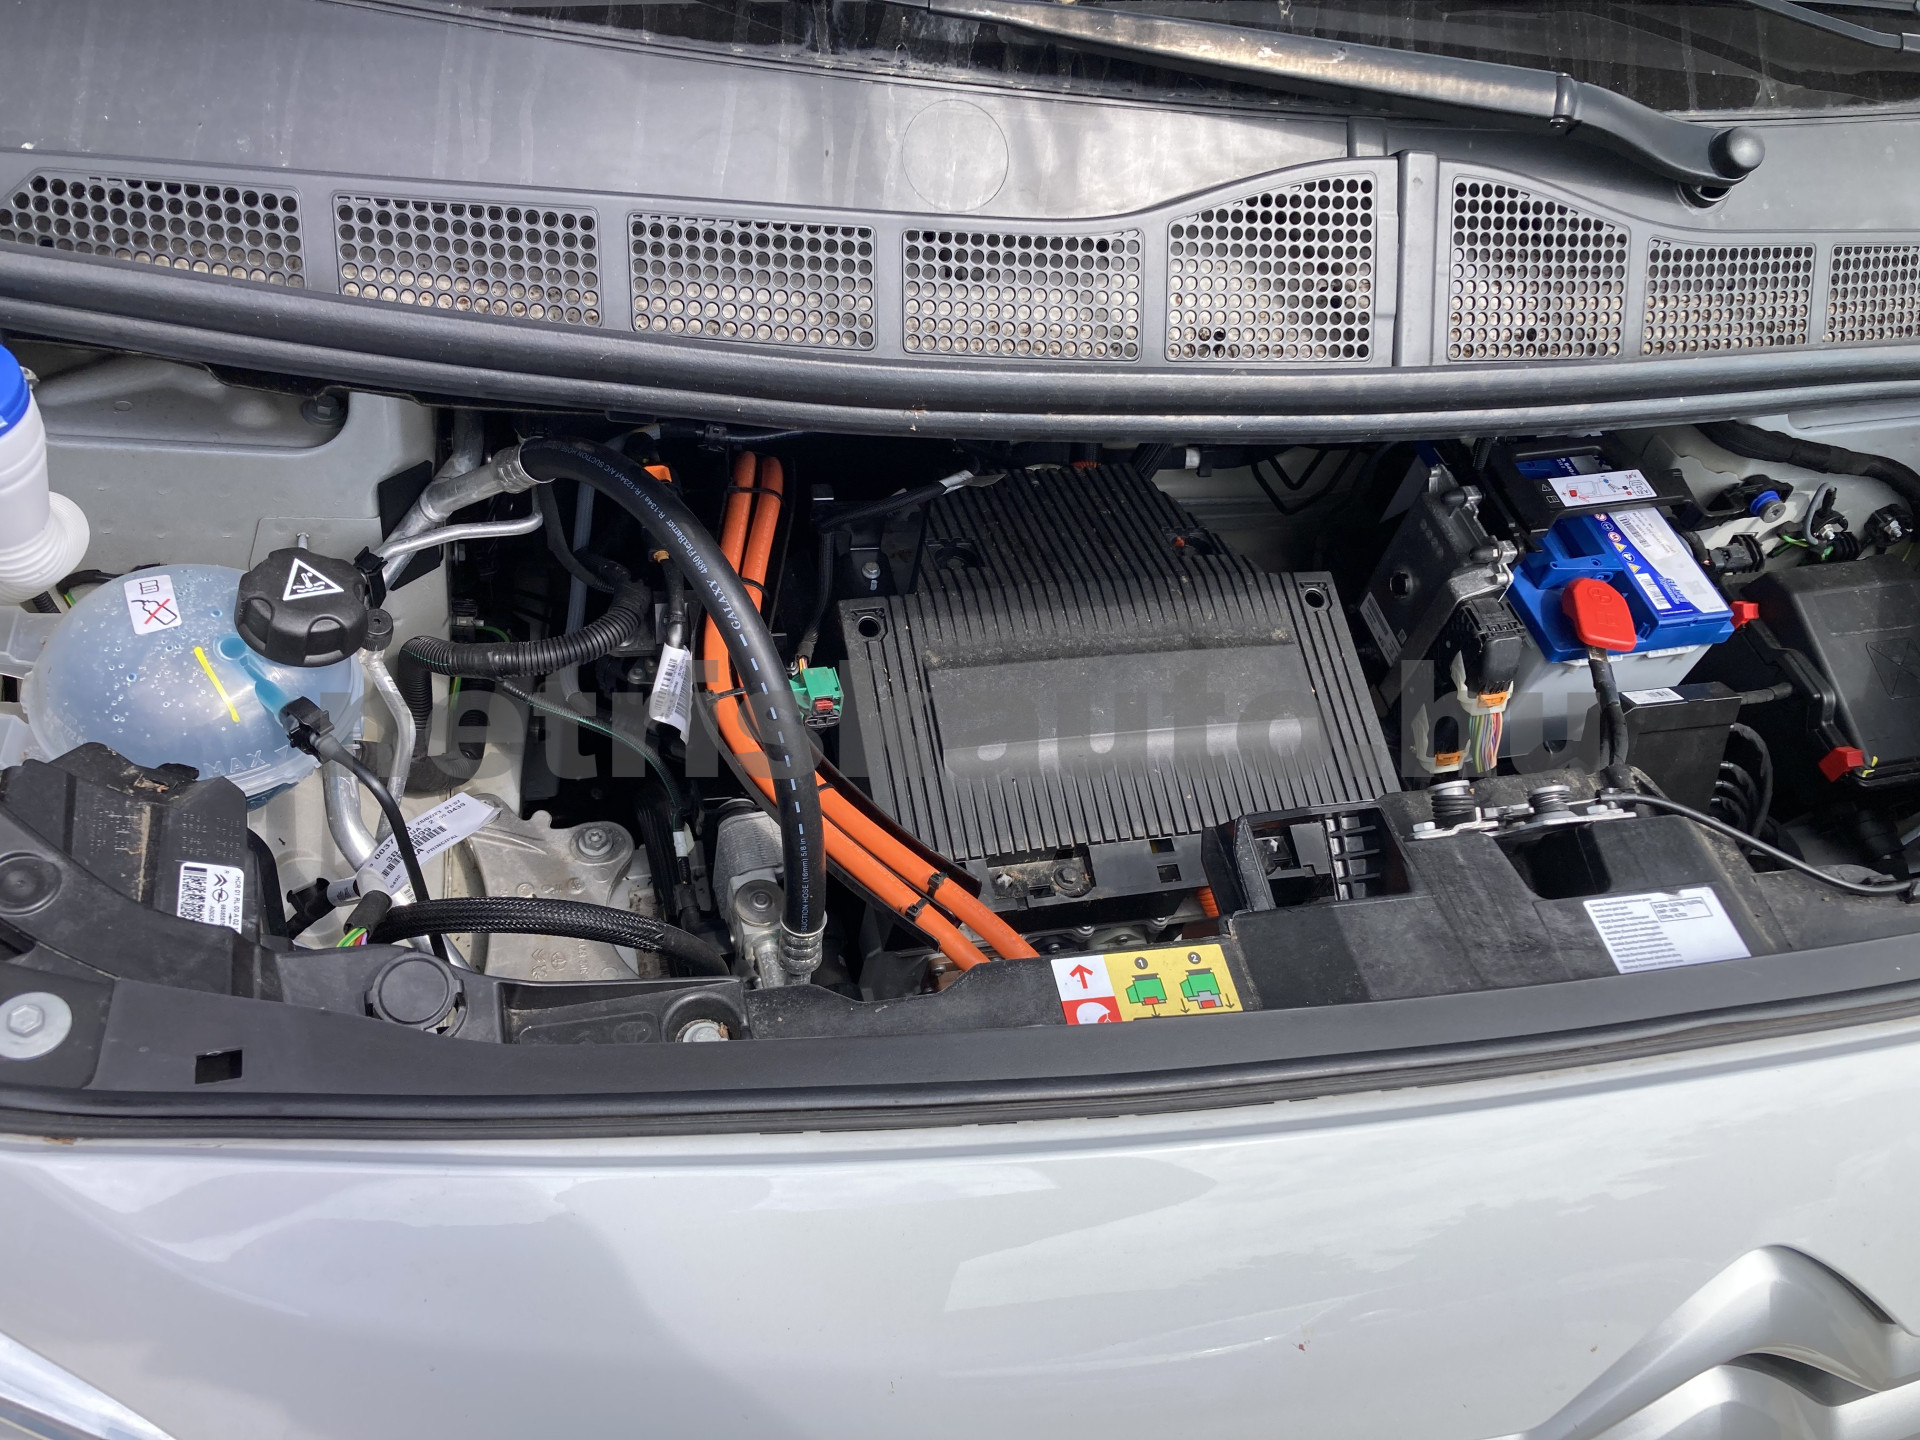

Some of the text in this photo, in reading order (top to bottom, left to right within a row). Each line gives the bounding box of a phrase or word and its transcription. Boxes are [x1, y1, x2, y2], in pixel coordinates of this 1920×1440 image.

[576, 449, 605, 468] SUCTION
[603, 464, 616, 475] A/C
[614, 471, 642, 496] R-1234yf
[644, 496, 666, 519] R-134a
[665, 519, 697, 557] FlexBarrier
[692, 555, 708, 574] 4880
[706, 579, 741, 630] GALAXY
[203, 750, 266, 777] MAX
[426, 834, 459, 854] PRINCIPAL
[800, 845, 808, 857] 5/8
[801, 837, 806, 845] in
[801, 859, 810, 883] (16mm)
[801, 904, 809, 932] SUCTION
